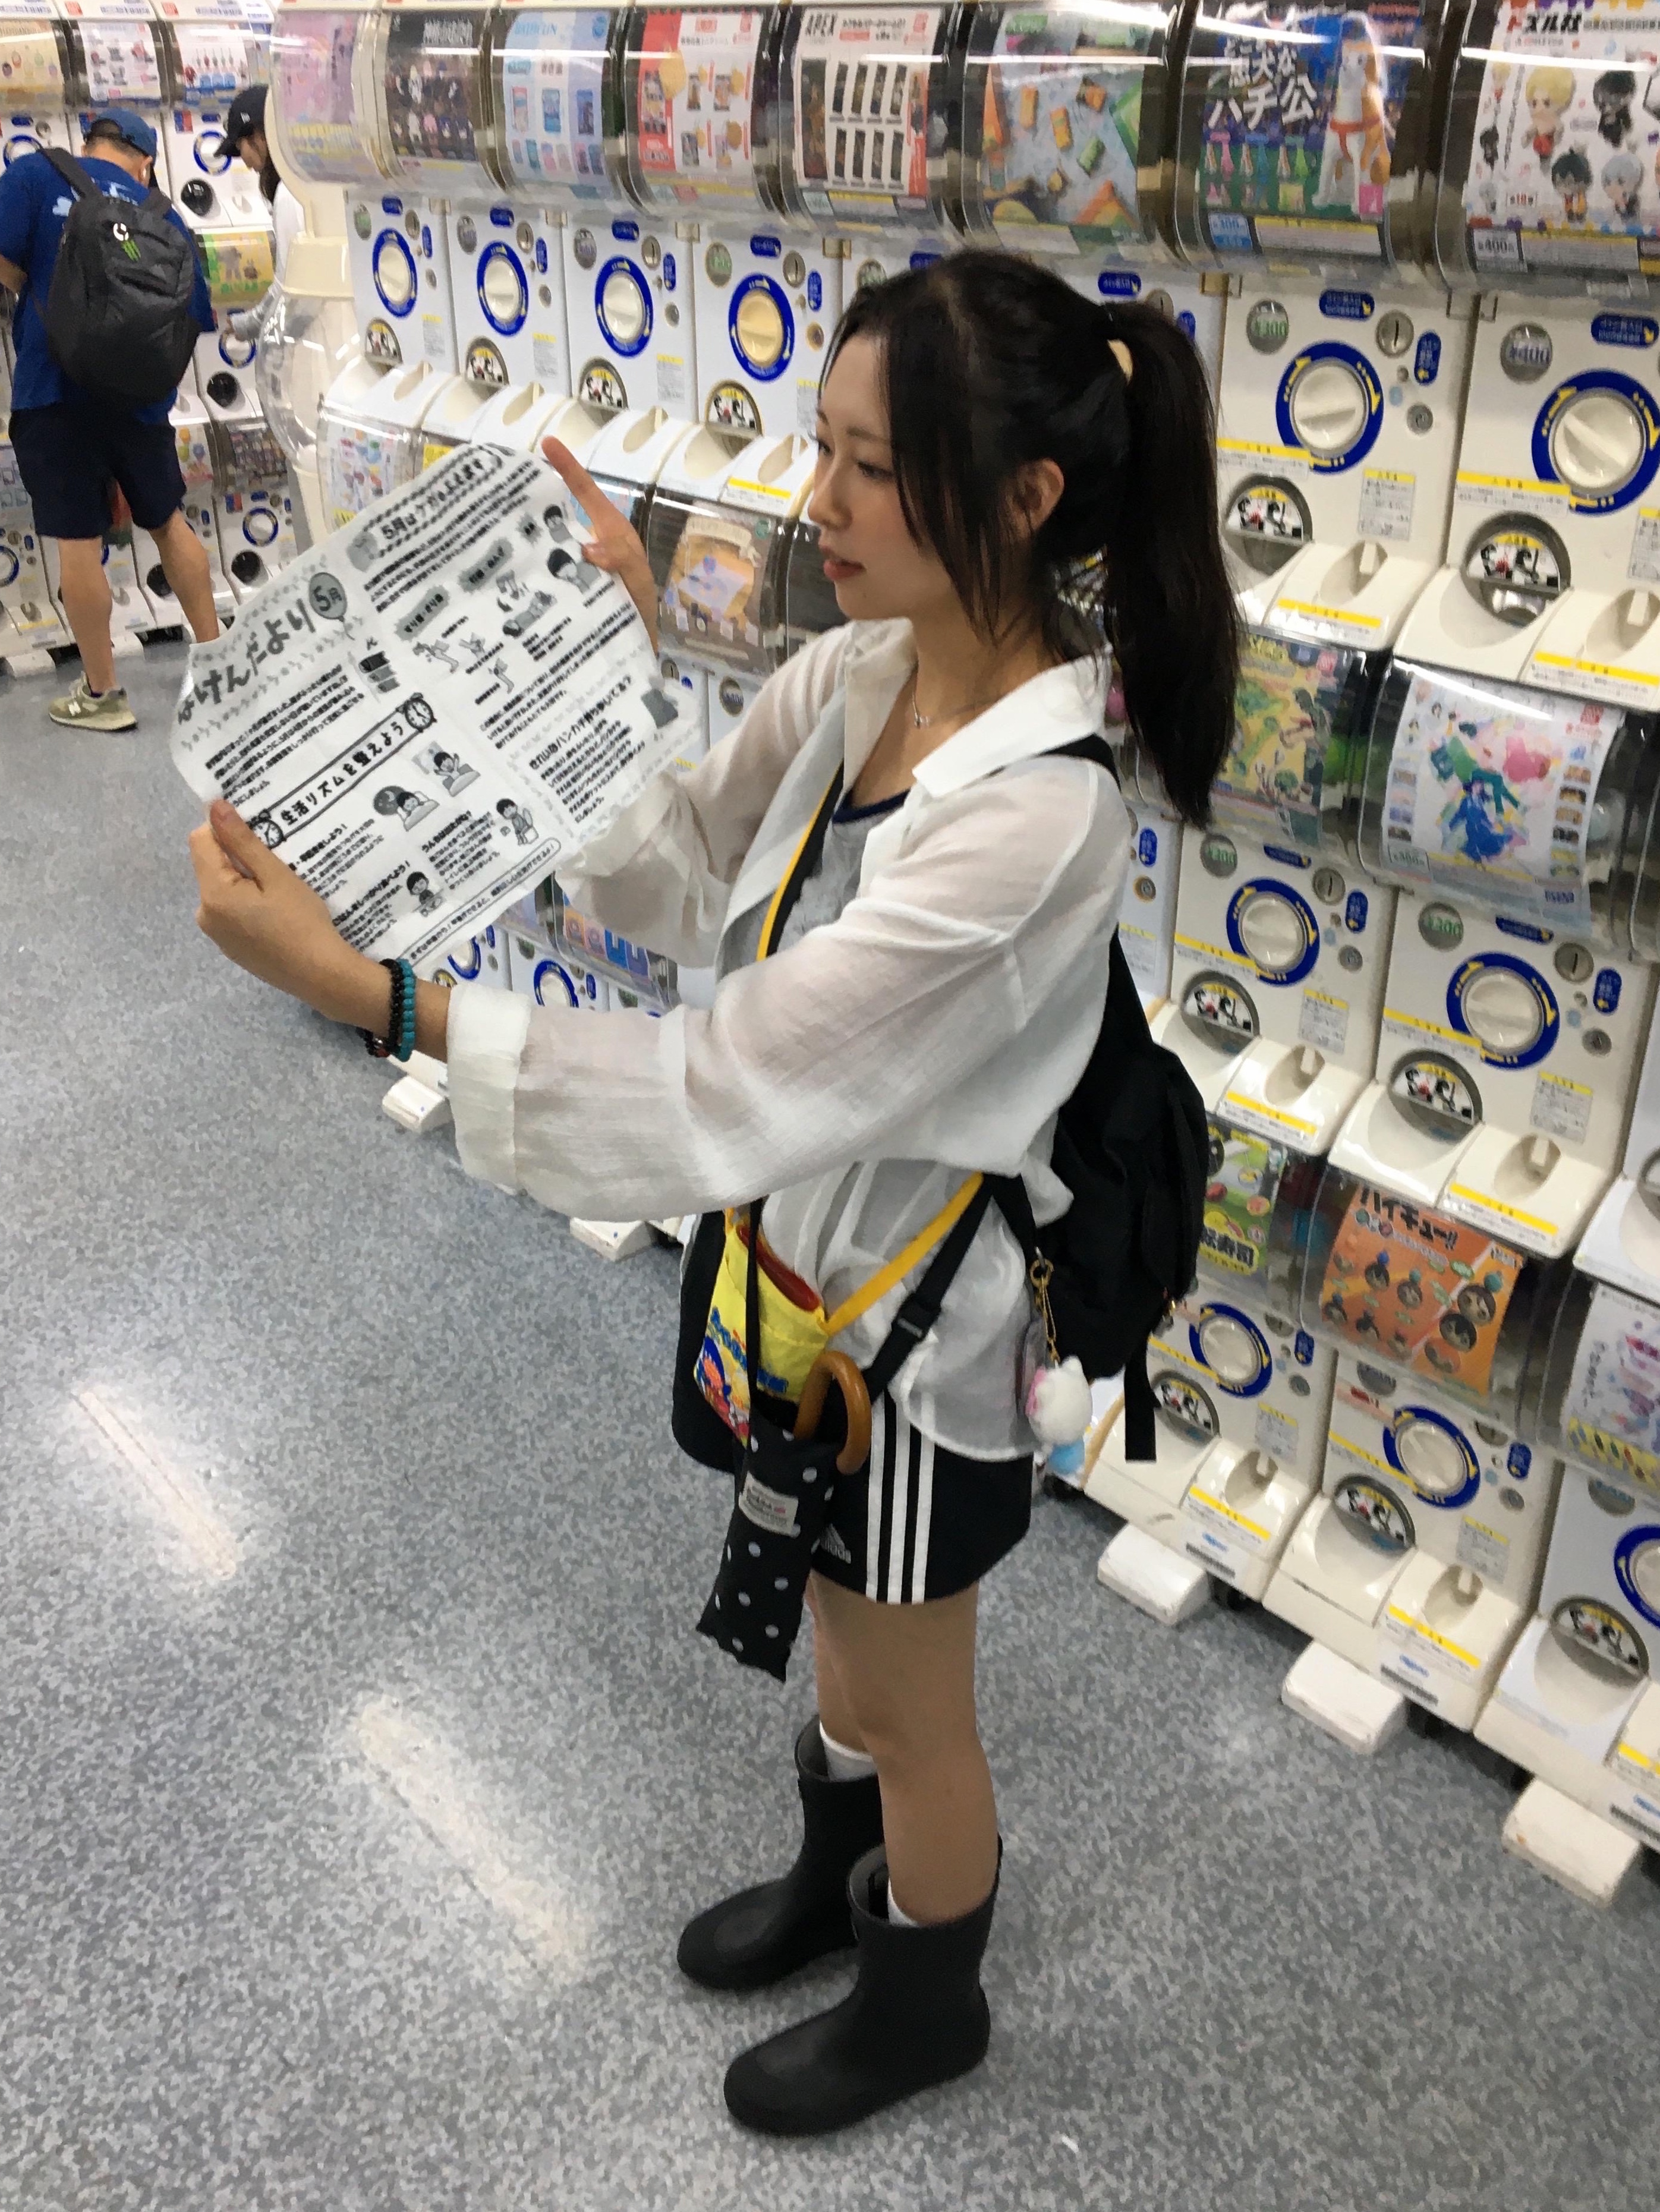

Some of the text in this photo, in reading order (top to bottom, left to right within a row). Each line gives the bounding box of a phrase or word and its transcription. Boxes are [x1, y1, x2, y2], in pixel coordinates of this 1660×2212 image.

[1208, 73, 1318, 130] ハチ公
[311, 586, 342, 612] 5月
[280, 721, 403, 825] 生活リズムを整えよう
